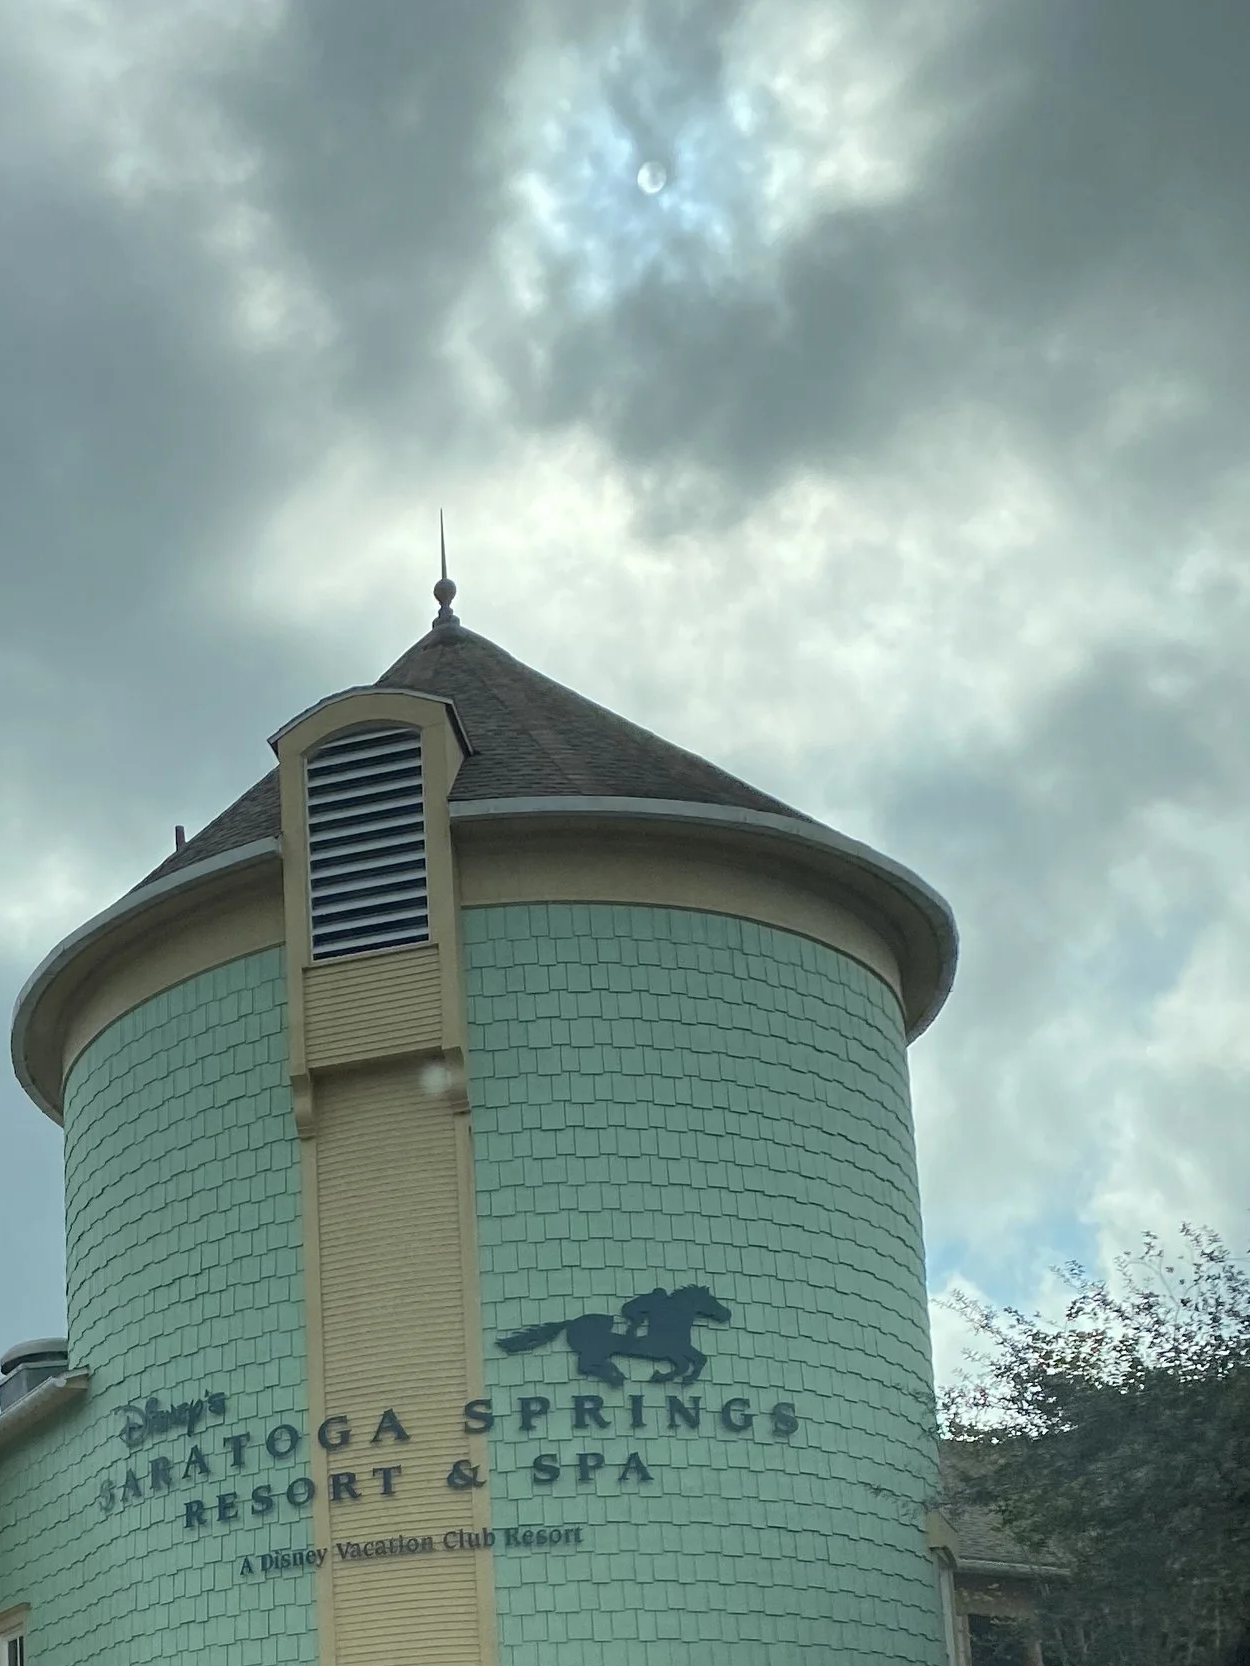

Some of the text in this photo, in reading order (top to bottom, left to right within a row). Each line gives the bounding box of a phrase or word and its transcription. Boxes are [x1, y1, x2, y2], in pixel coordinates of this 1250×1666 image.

[115, 1389, 226, 1448] Disney's
[99, 1394, 800, 1513] SARATOGA SPRINGS
[184, 1451, 655, 1529] RESORT & SPA
[239, 1525, 585, 1576] A Disney Vacation Club Resort
